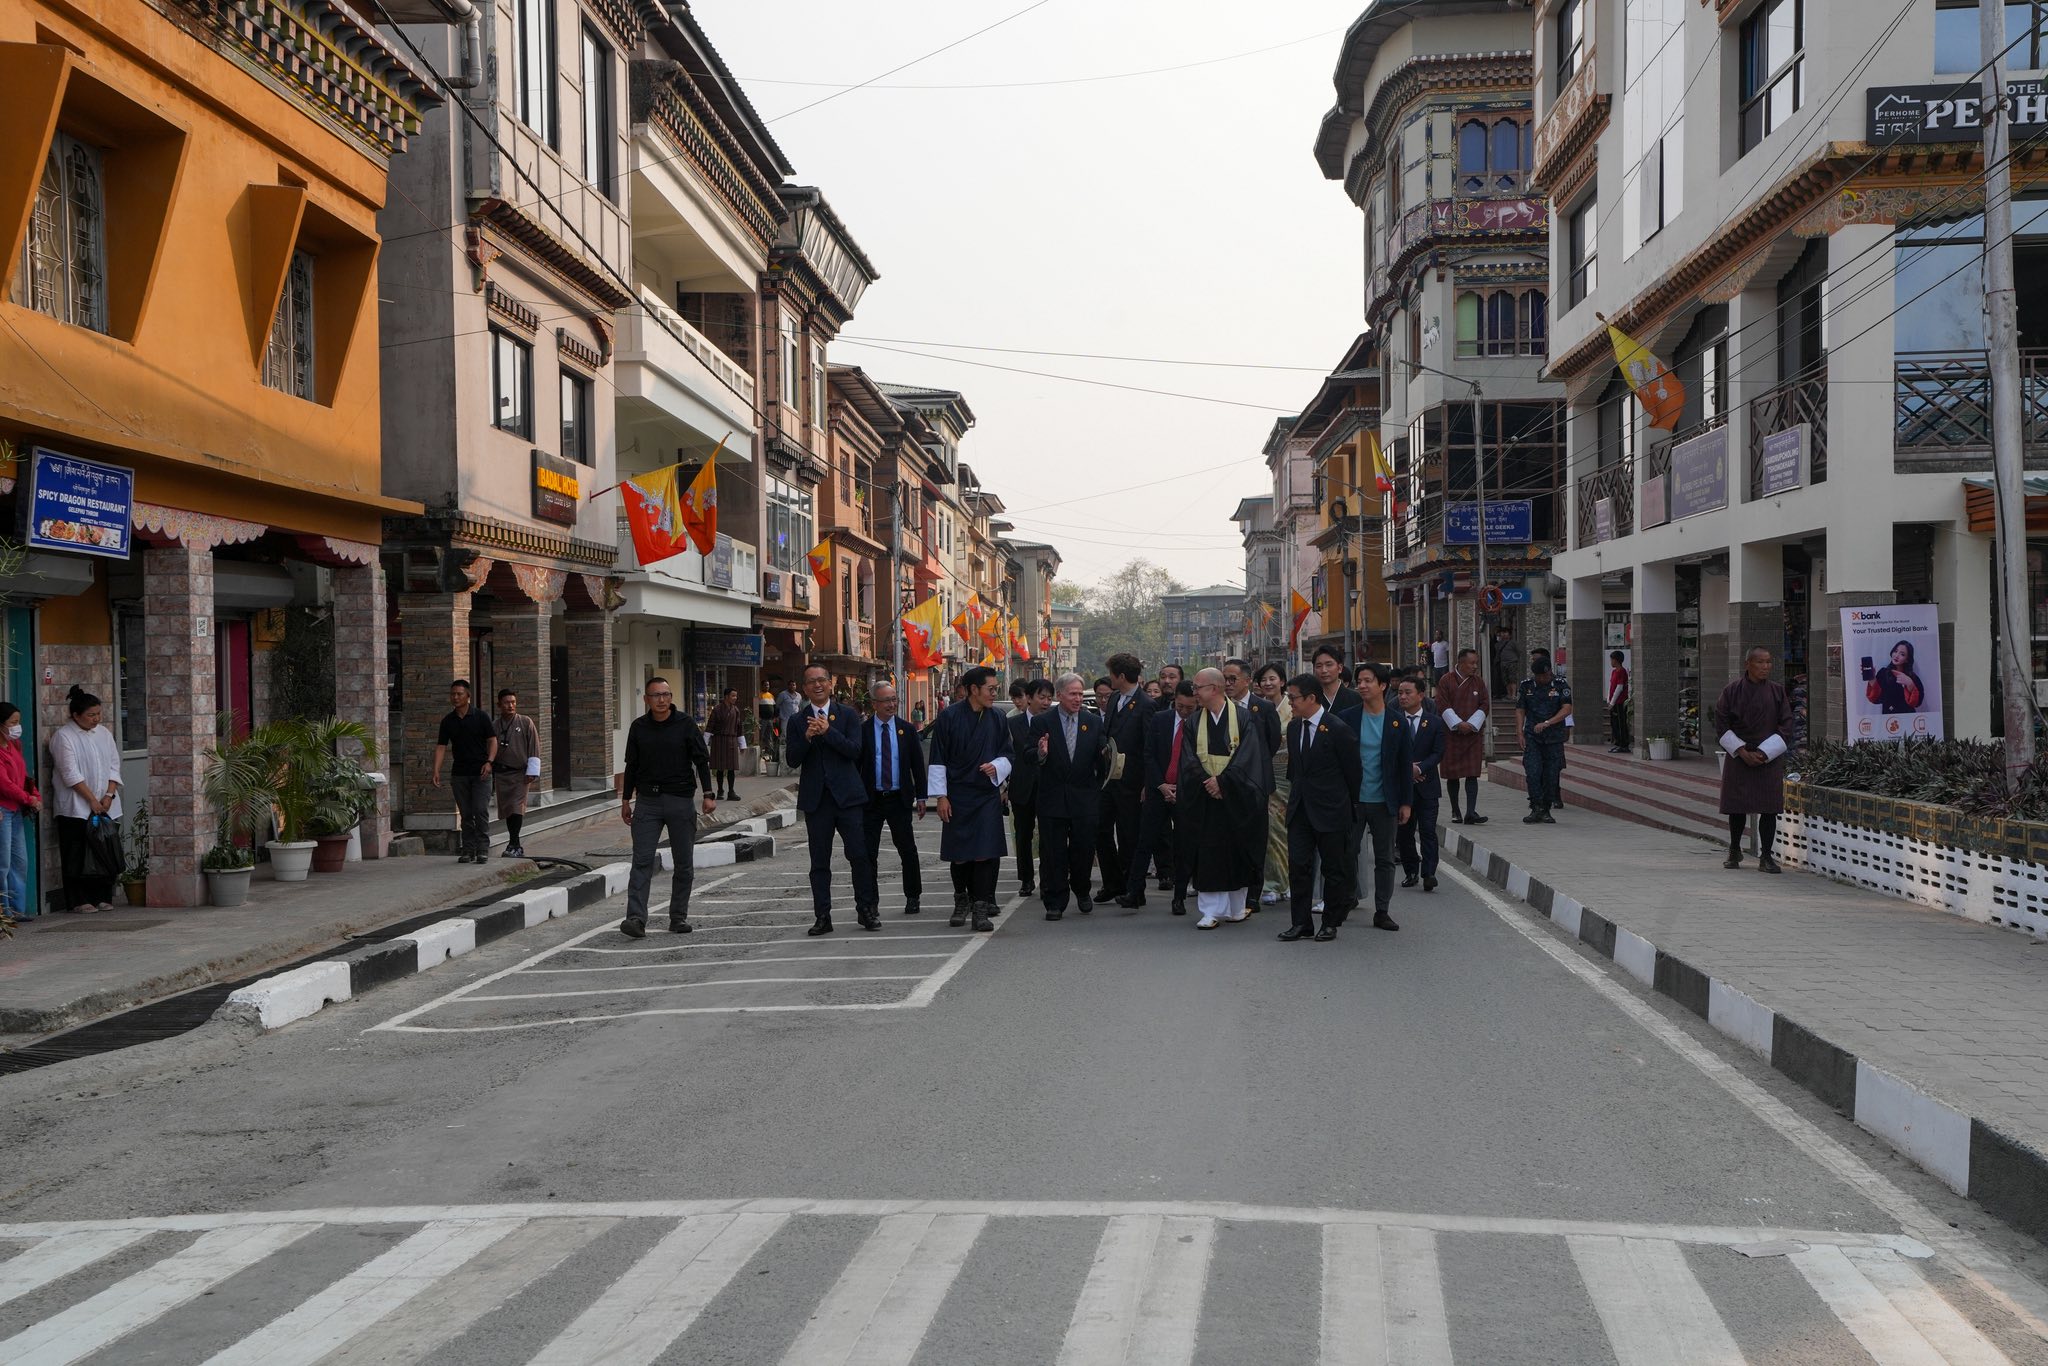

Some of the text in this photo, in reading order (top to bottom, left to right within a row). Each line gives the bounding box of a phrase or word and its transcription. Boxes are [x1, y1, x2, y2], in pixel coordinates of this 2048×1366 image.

[2006, 84, 2045, 95] OTEL
[1924, 96, 2048, 130] PEH
[537, 466, 580, 500] BADAL HOTEL
[38, 489, 59, 501] SPICY
[60, 493, 86, 506] DRAGON
[87, 498, 126, 514] RESTAURANT
[68, 506, 85, 515] GELEPHU
